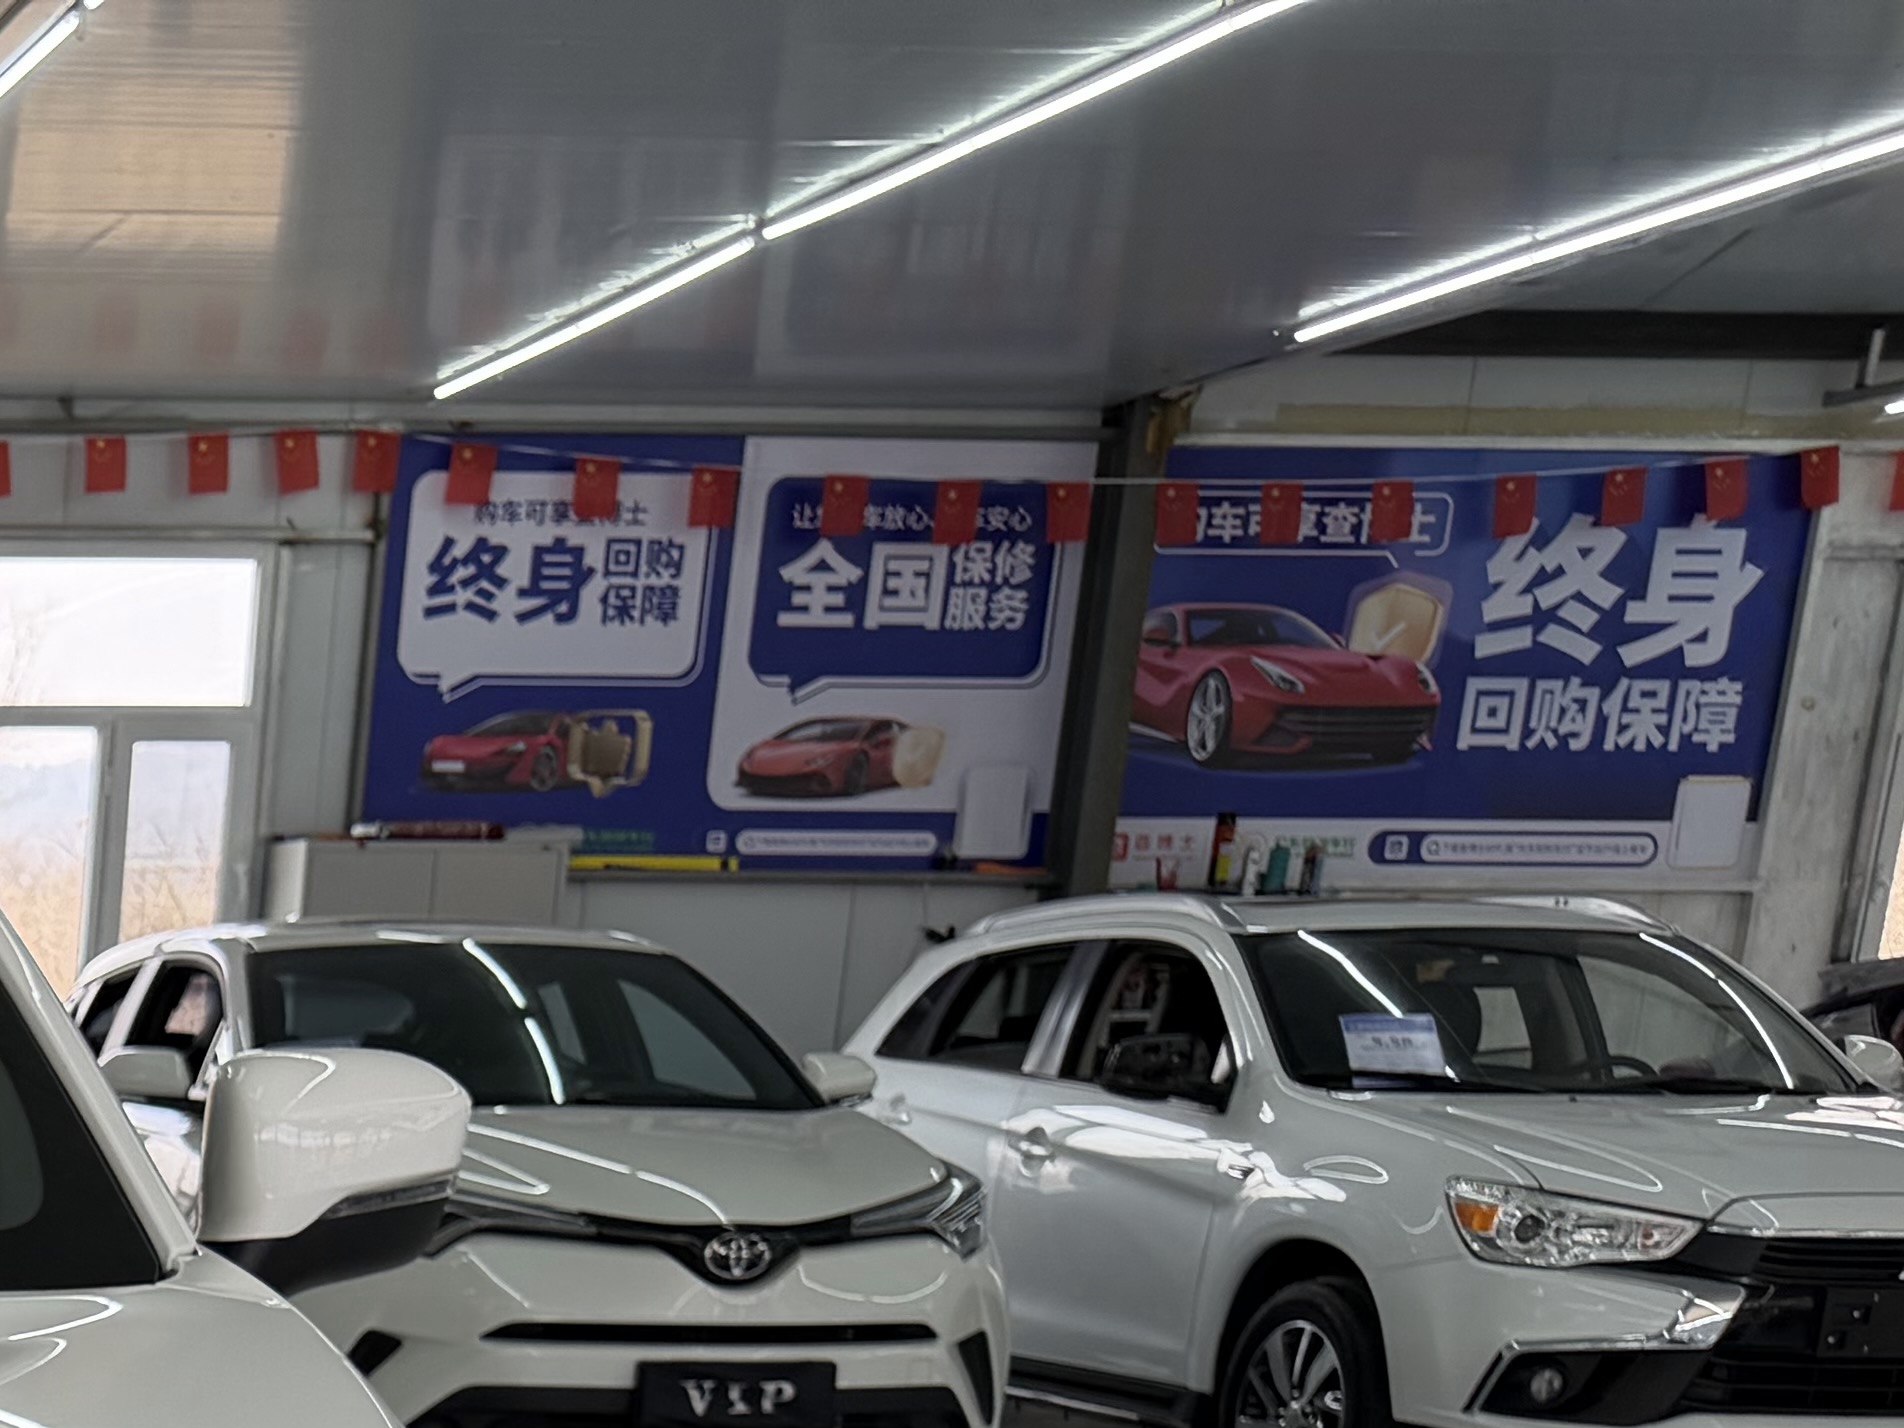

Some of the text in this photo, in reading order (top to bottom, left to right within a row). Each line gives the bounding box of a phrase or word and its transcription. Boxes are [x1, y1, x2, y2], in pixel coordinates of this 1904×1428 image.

[422, 534, 596, 626] 终身
[603, 537, 686, 580] 回购
[953, 538, 1037, 586] 保修
[598, 584, 681, 627] 保障
[776, 536, 949, 631] 全国
[943, 584, 1031, 631] 服务
[1473, 510, 1765, 669] 终身
[1456, 675, 1745, 753] 回购保障
[679, 1379, 798, 1419] VIP
